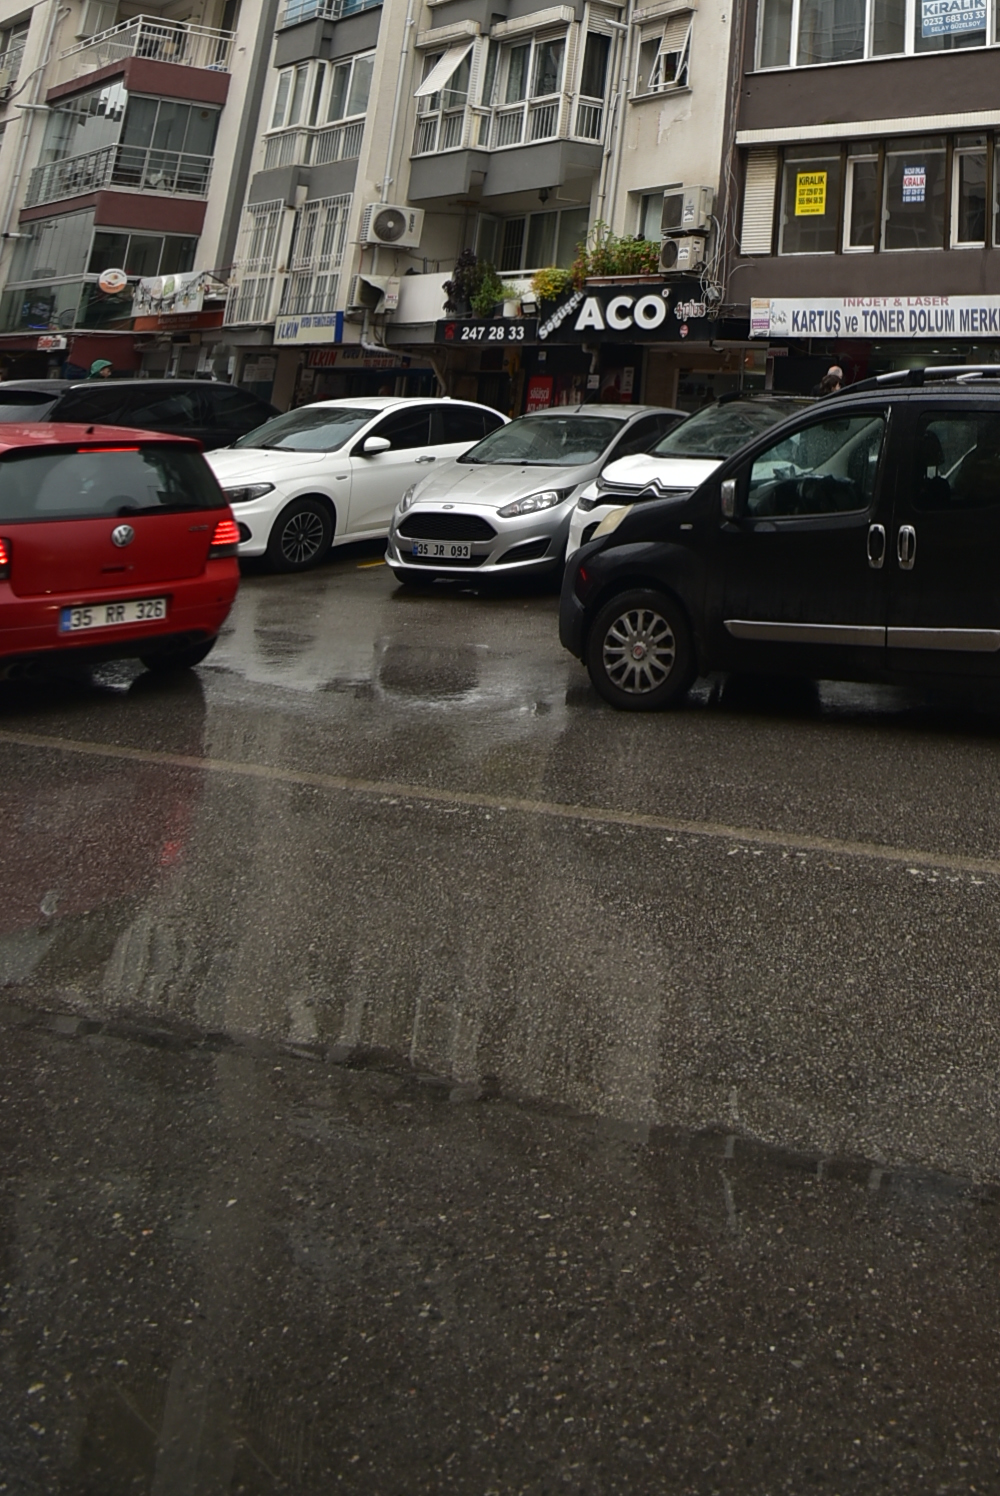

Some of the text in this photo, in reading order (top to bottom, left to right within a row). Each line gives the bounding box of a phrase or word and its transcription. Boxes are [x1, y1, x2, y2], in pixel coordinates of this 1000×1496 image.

[924, 10, 986, 26] 0232 683 03 33
[843, 296, 950, 307] INKJET & LASER
[574, 294, 667, 331] ACO
[845, 315, 859, 332] ve
[862, 310, 905, 332] TONER
[909, 308, 955, 332] DOLUM
[460, 326, 525, 341] 247 28 33
[418, 544, 468, 556] 35 JR 093
[71, 601, 163, 628] 35 RR 326
